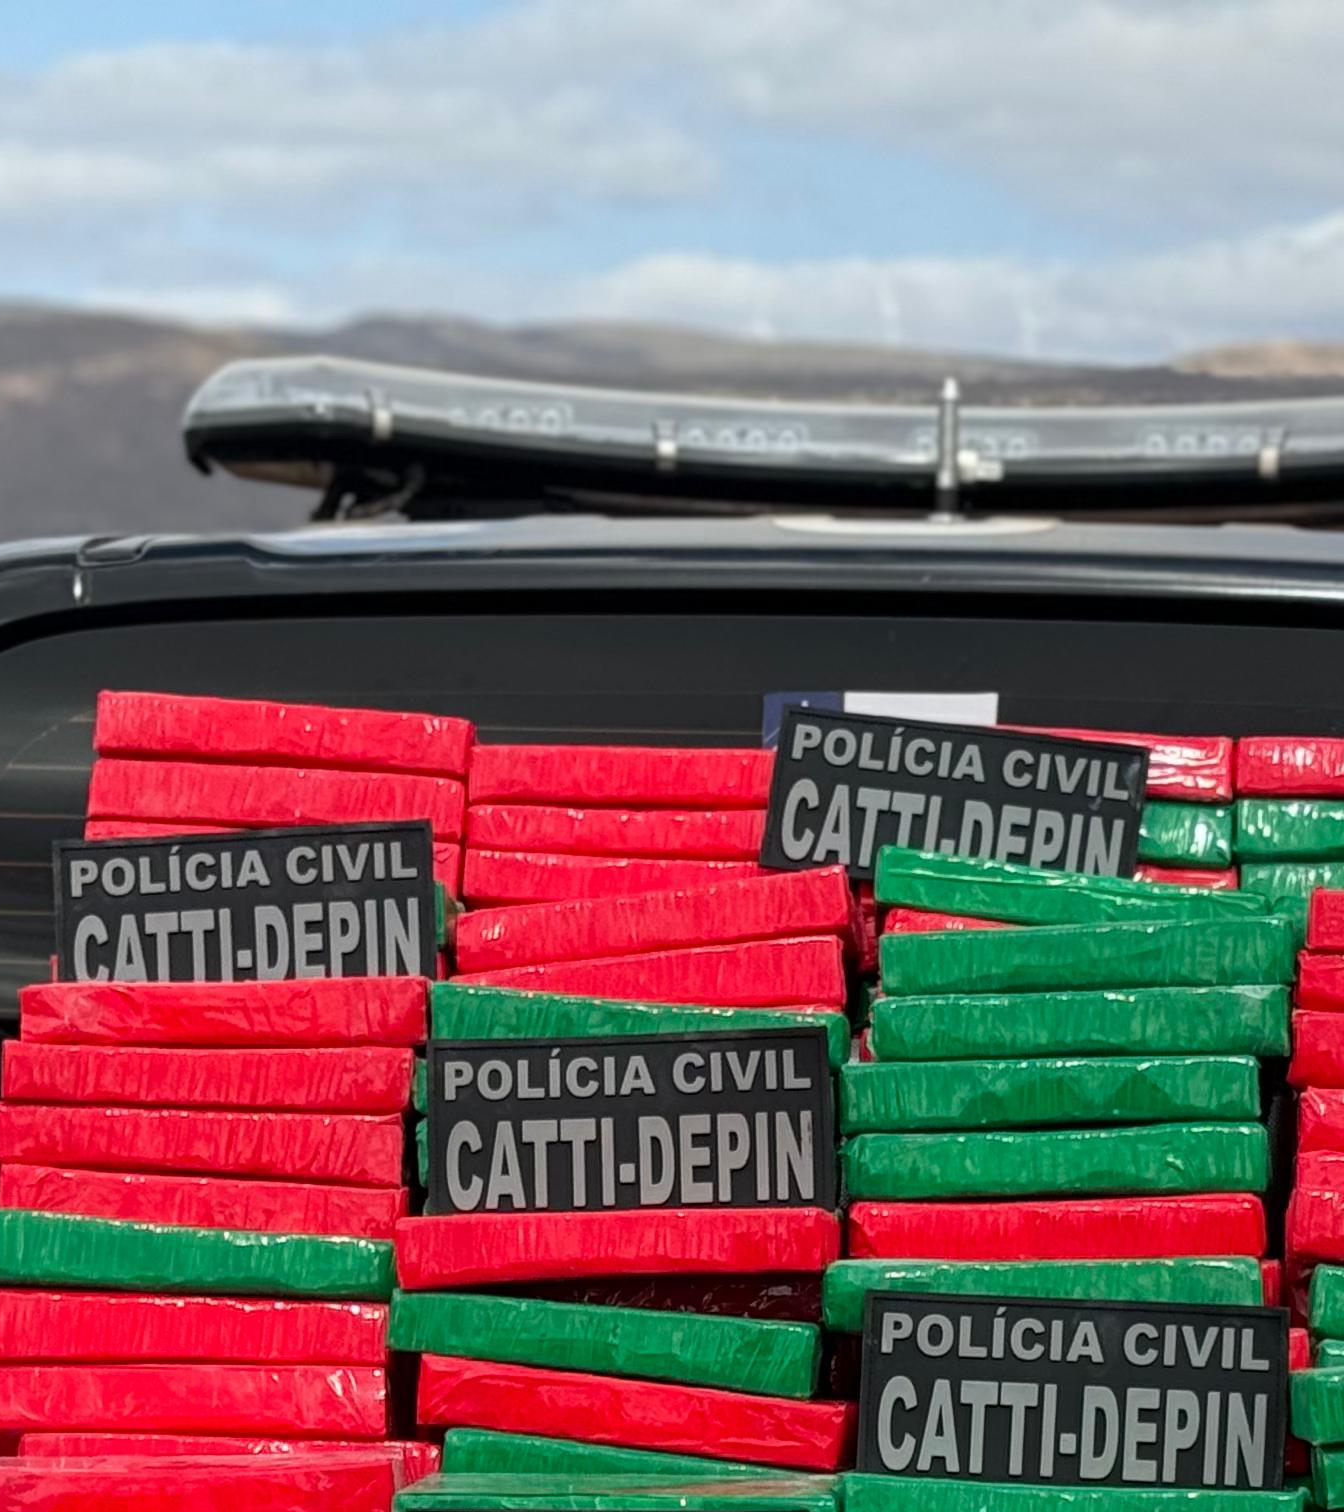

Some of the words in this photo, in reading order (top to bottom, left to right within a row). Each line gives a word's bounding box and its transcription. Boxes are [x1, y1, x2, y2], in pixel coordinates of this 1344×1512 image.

[791, 722, 986, 783] POLÍCIA
[1002, 749, 1130, 800] CIVIL
[70, 847, 271, 898] POLÍCIA
[285, 841, 418, 886] CIVIL
[73, 897, 422, 984] CATTI-DEPIN
[443, 1048, 656, 1100] POLÍCIA
[672, 1048, 812, 1093] CIVIL
[445, 1110, 815, 1211] CATTI-DEPIN
[880, 1306, 1105, 1363] POLÍCIA
[1123, 1322, 1270, 1371] CIVIL
[877, 1375, 1269, 1488] CATTI-DEPIN
